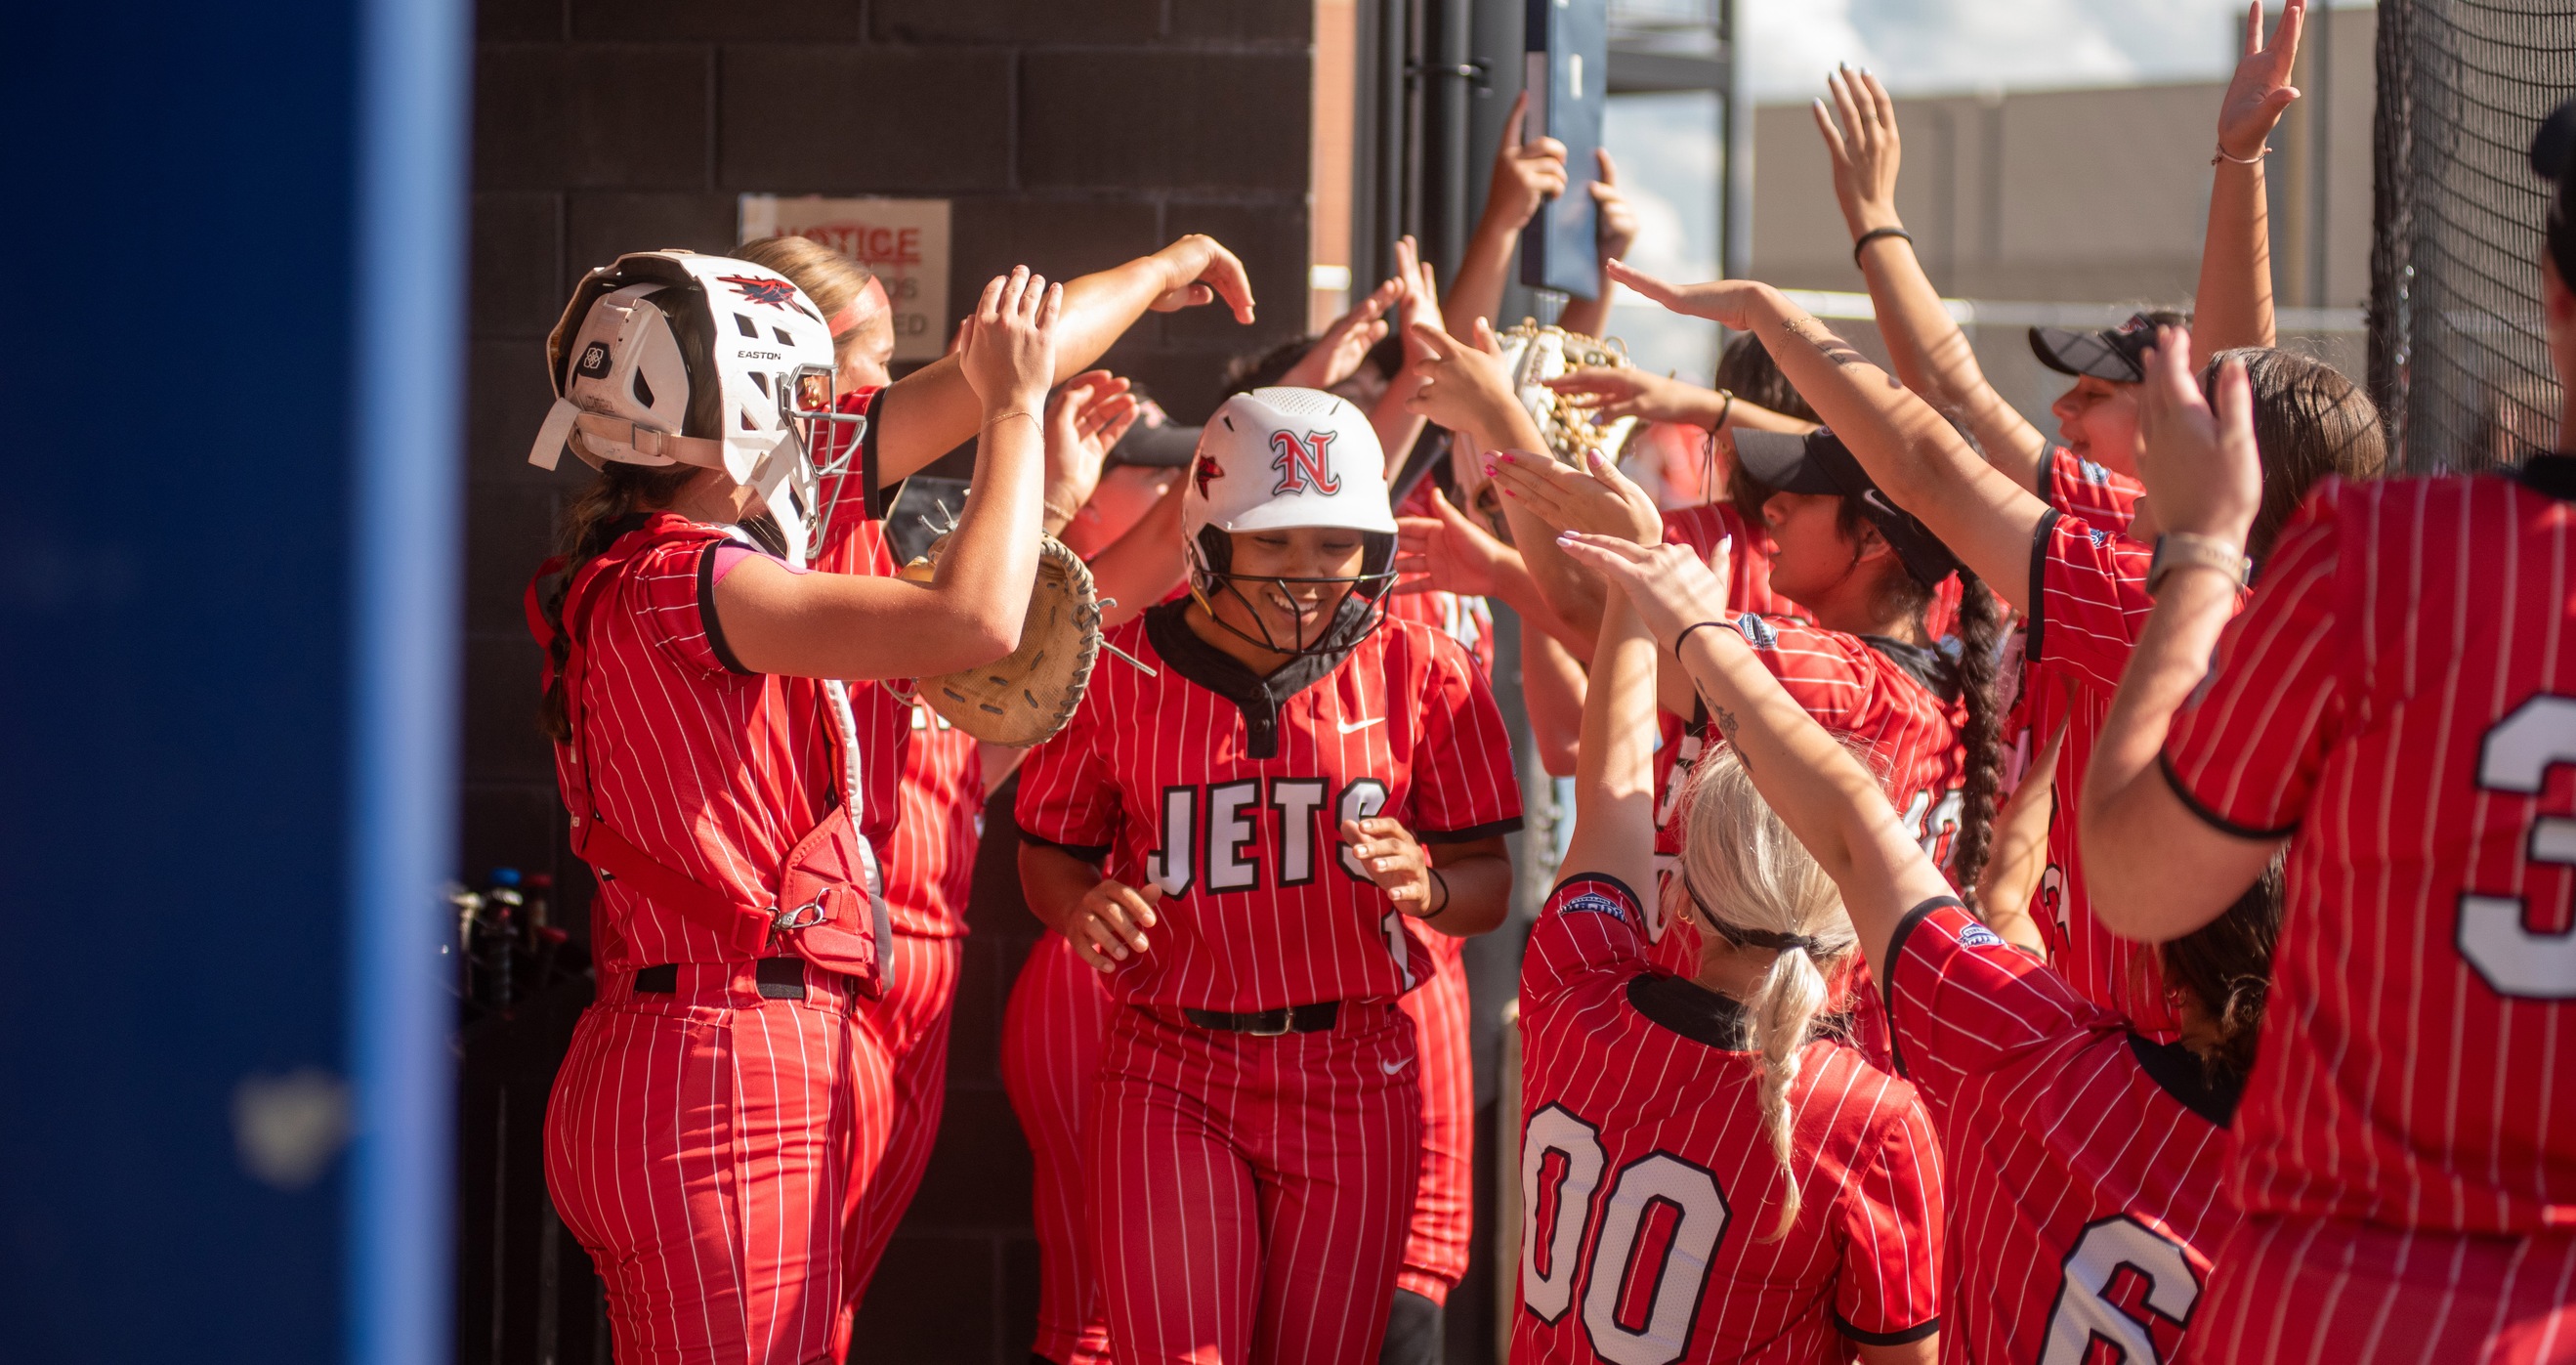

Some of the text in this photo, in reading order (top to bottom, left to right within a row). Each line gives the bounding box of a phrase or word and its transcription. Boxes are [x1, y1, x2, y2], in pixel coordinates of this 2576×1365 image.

[738, 350, 781, 361] EASTON
[1270, 429, 1341, 496] N
[1522, 1100, 1732, 1365] 00
